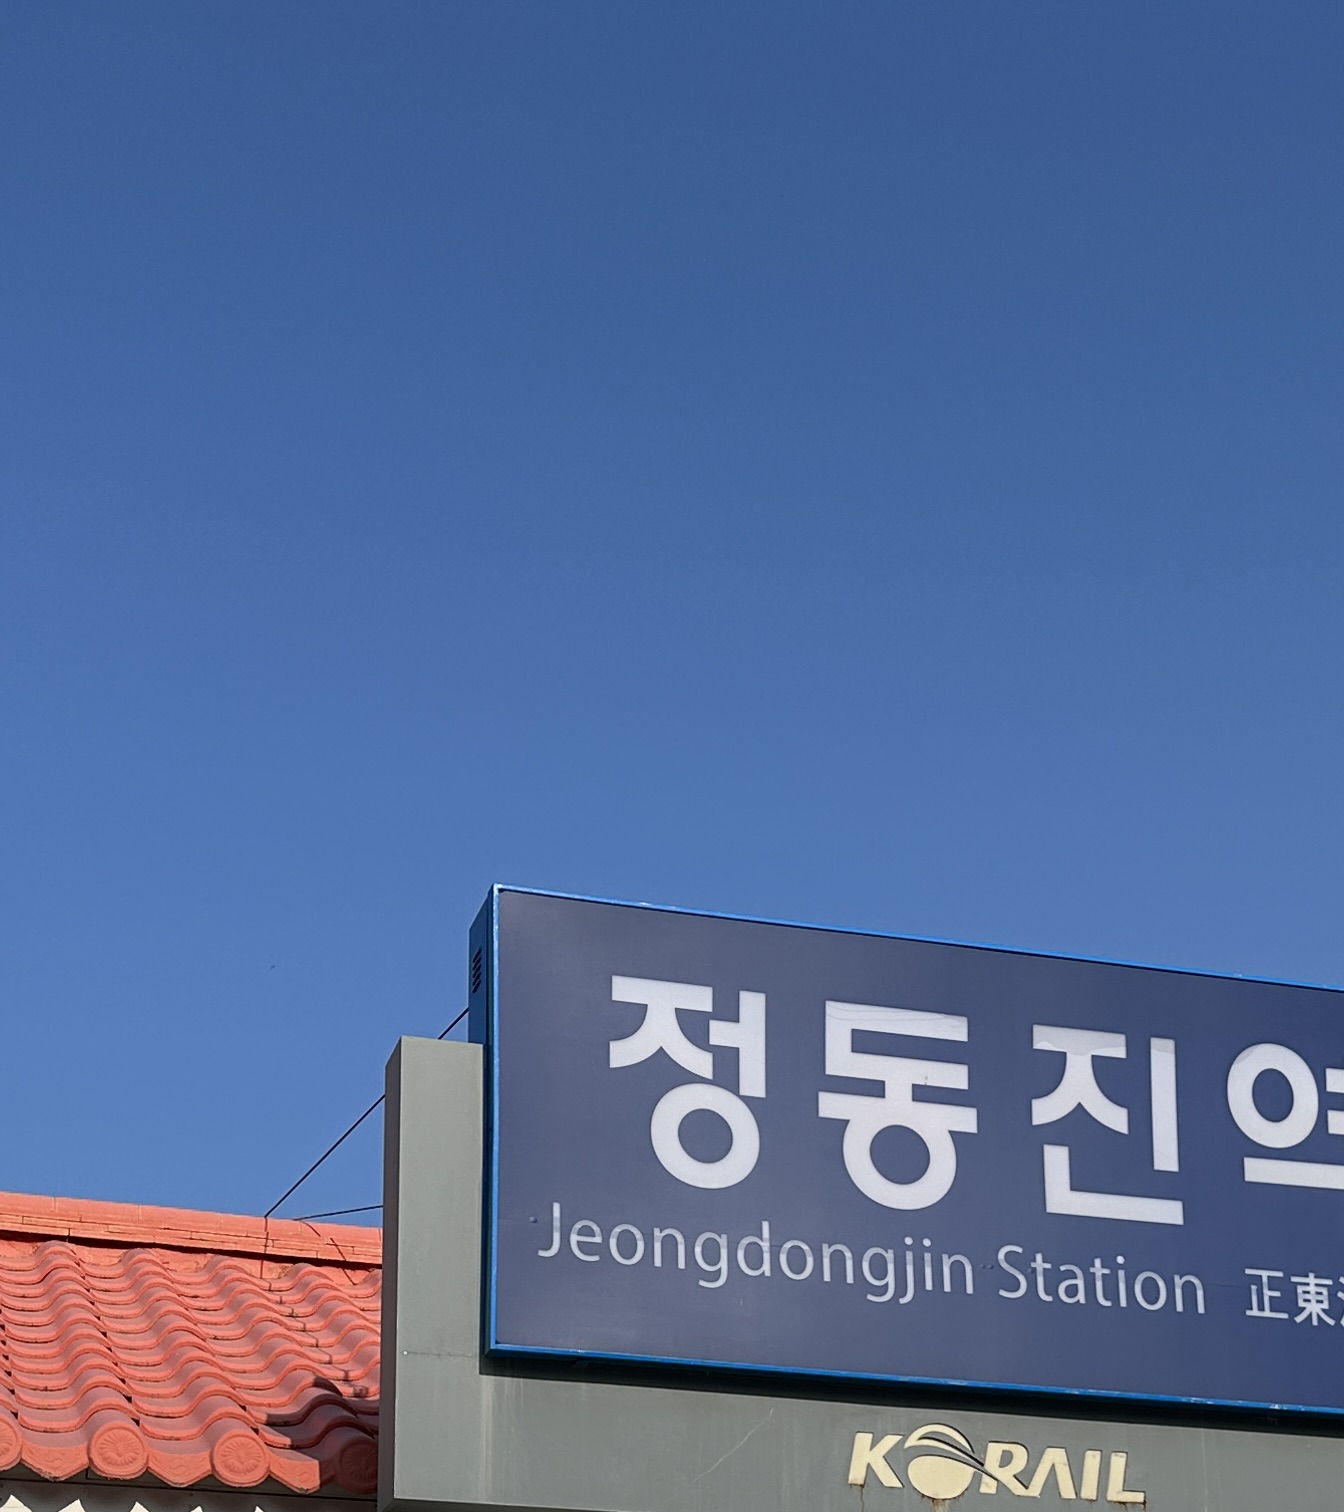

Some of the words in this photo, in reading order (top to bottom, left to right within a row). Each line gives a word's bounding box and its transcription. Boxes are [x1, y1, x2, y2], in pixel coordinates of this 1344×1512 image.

[537, 1202, 975, 1304] Jeongdongjin
[997, 1244, 1206, 1315] Station
[847, 1422, 1146, 1504] KORAIL
